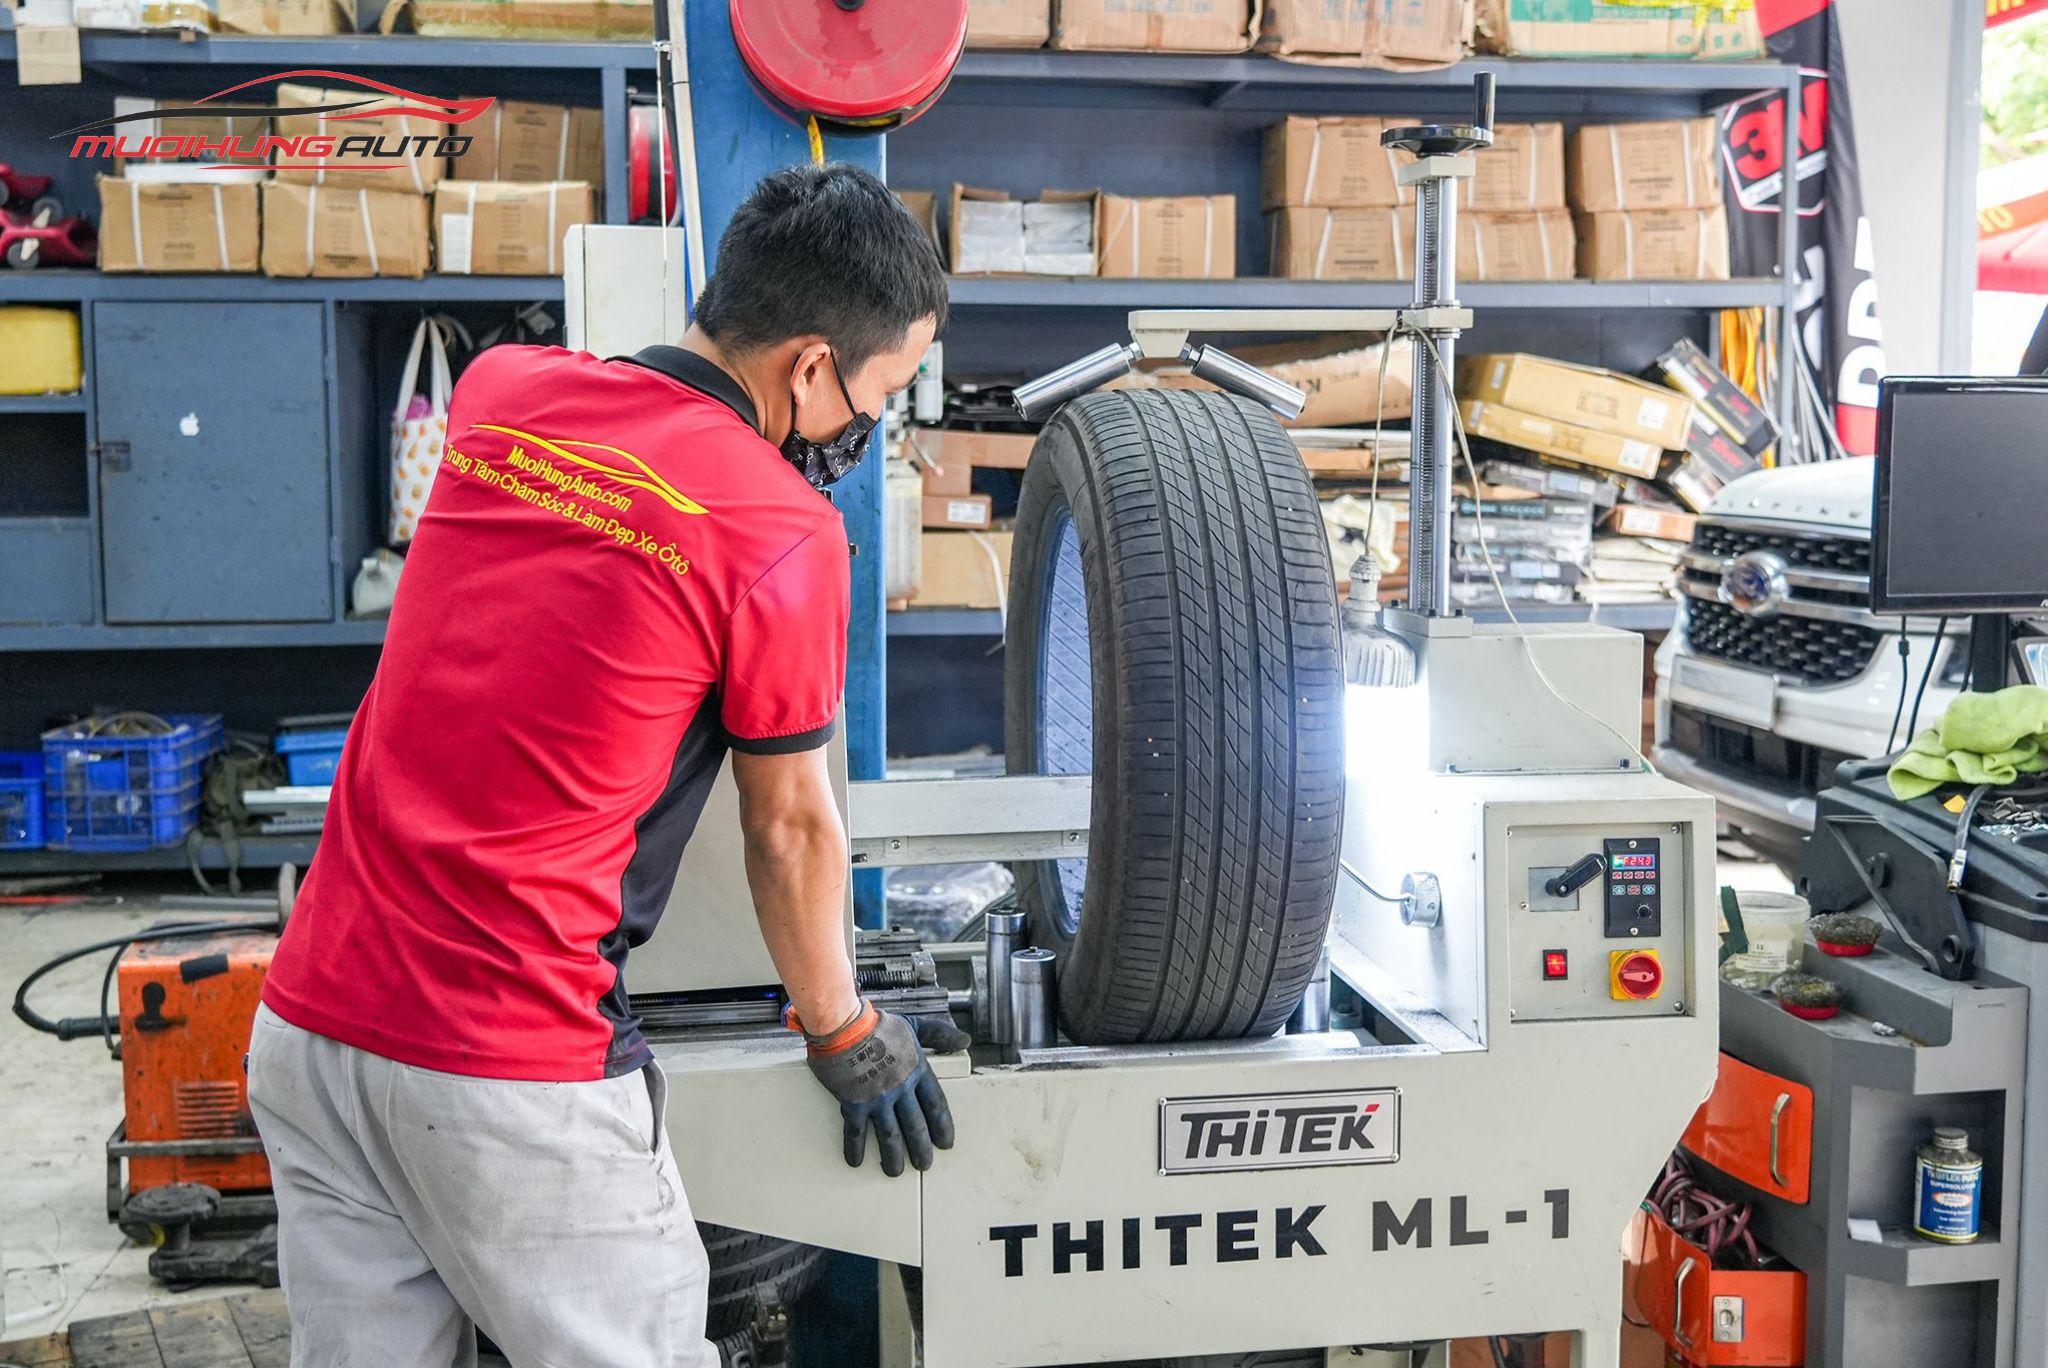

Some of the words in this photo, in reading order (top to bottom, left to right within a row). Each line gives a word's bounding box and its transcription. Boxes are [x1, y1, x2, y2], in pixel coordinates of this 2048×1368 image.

[445, 444, 472, 474] Trung
[472, 458, 500, 486] Tâm
[500, 473, 540, 505] Chăm
[538, 491, 565, 514] Sóc
[562, 502, 576, 519] &
[572, 505, 605, 532] Làm
[604, 518, 636, 546] Đẹp
[633, 531, 659, 555] Xe
[658, 542, 690, 576] Ôtô
[506, 444, 633, 512] MuoiHungAuto.com
[989, 1204, 1328, 1278] THITEK
[1371, 1188, 1570, 1252] ML-1
